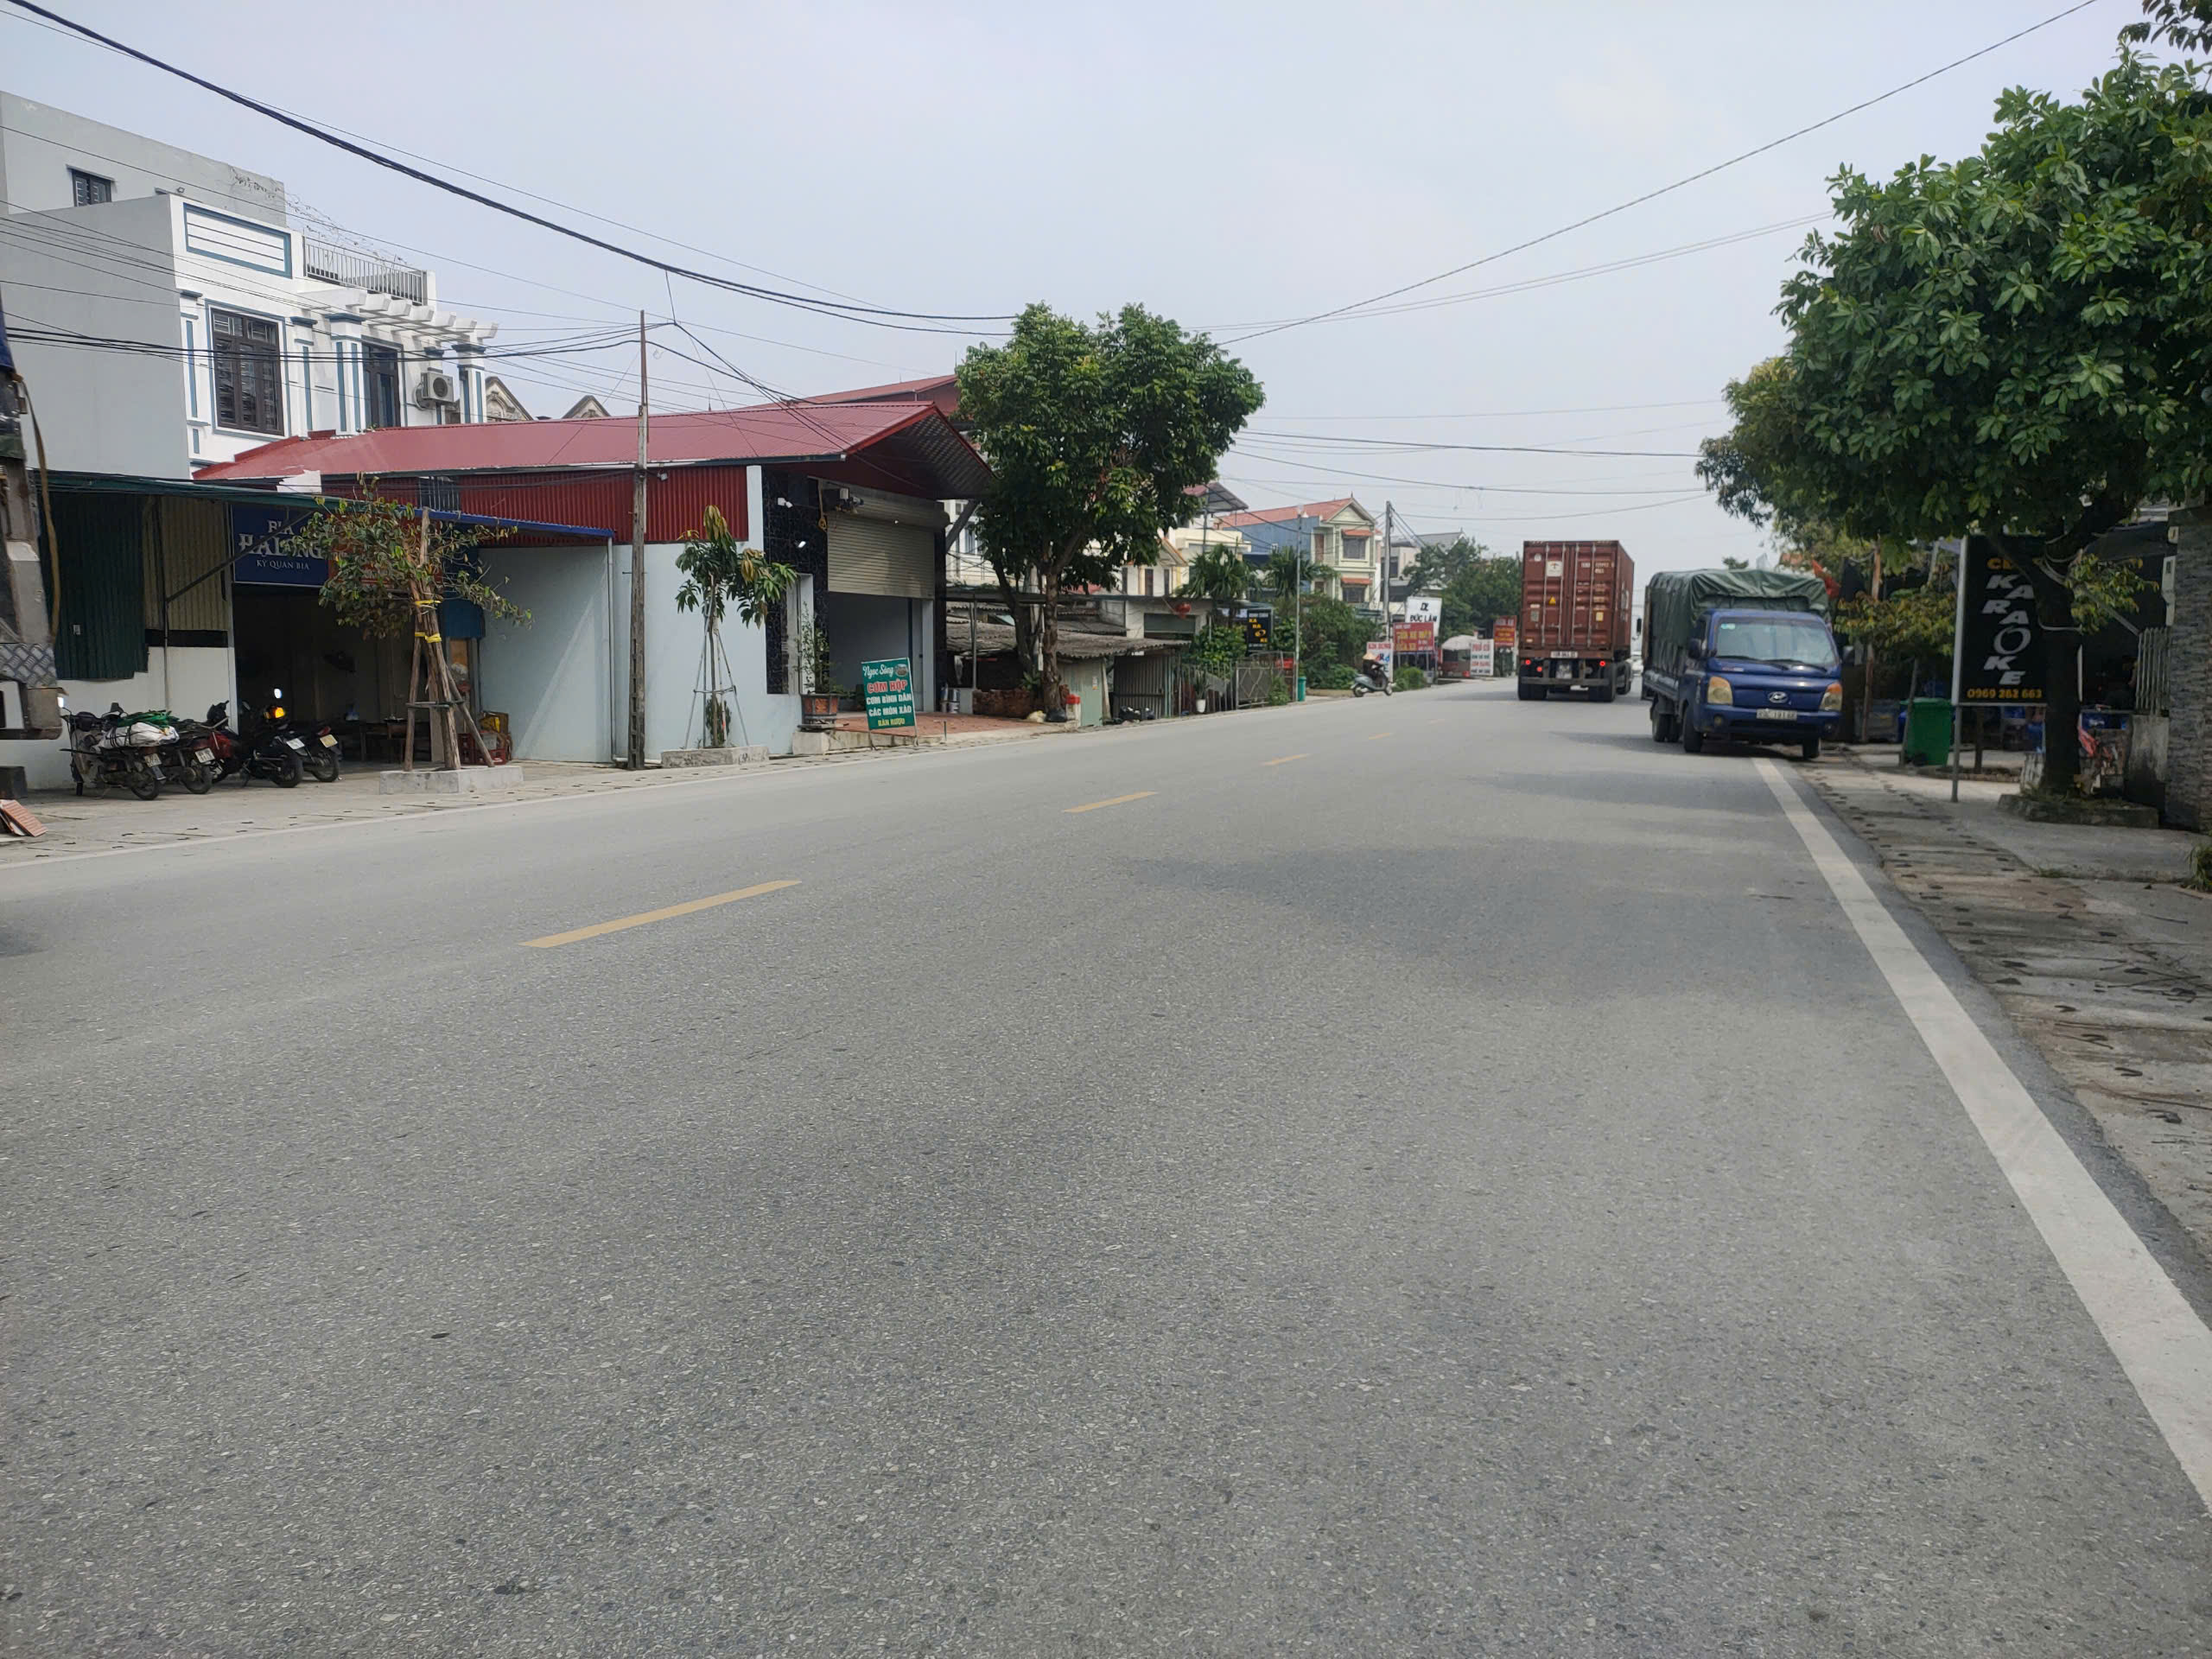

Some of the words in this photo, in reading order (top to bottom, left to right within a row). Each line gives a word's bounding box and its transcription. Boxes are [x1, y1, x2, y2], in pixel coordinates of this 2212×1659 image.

[270, 560, 294, 569] QUAN
[296, 562, 309, 570] BIA
[1981, 574, 2034, 684] KARAOKE
[868, 682, 887, 693] CƠM
[889, 677, 908, 693] HỘP
